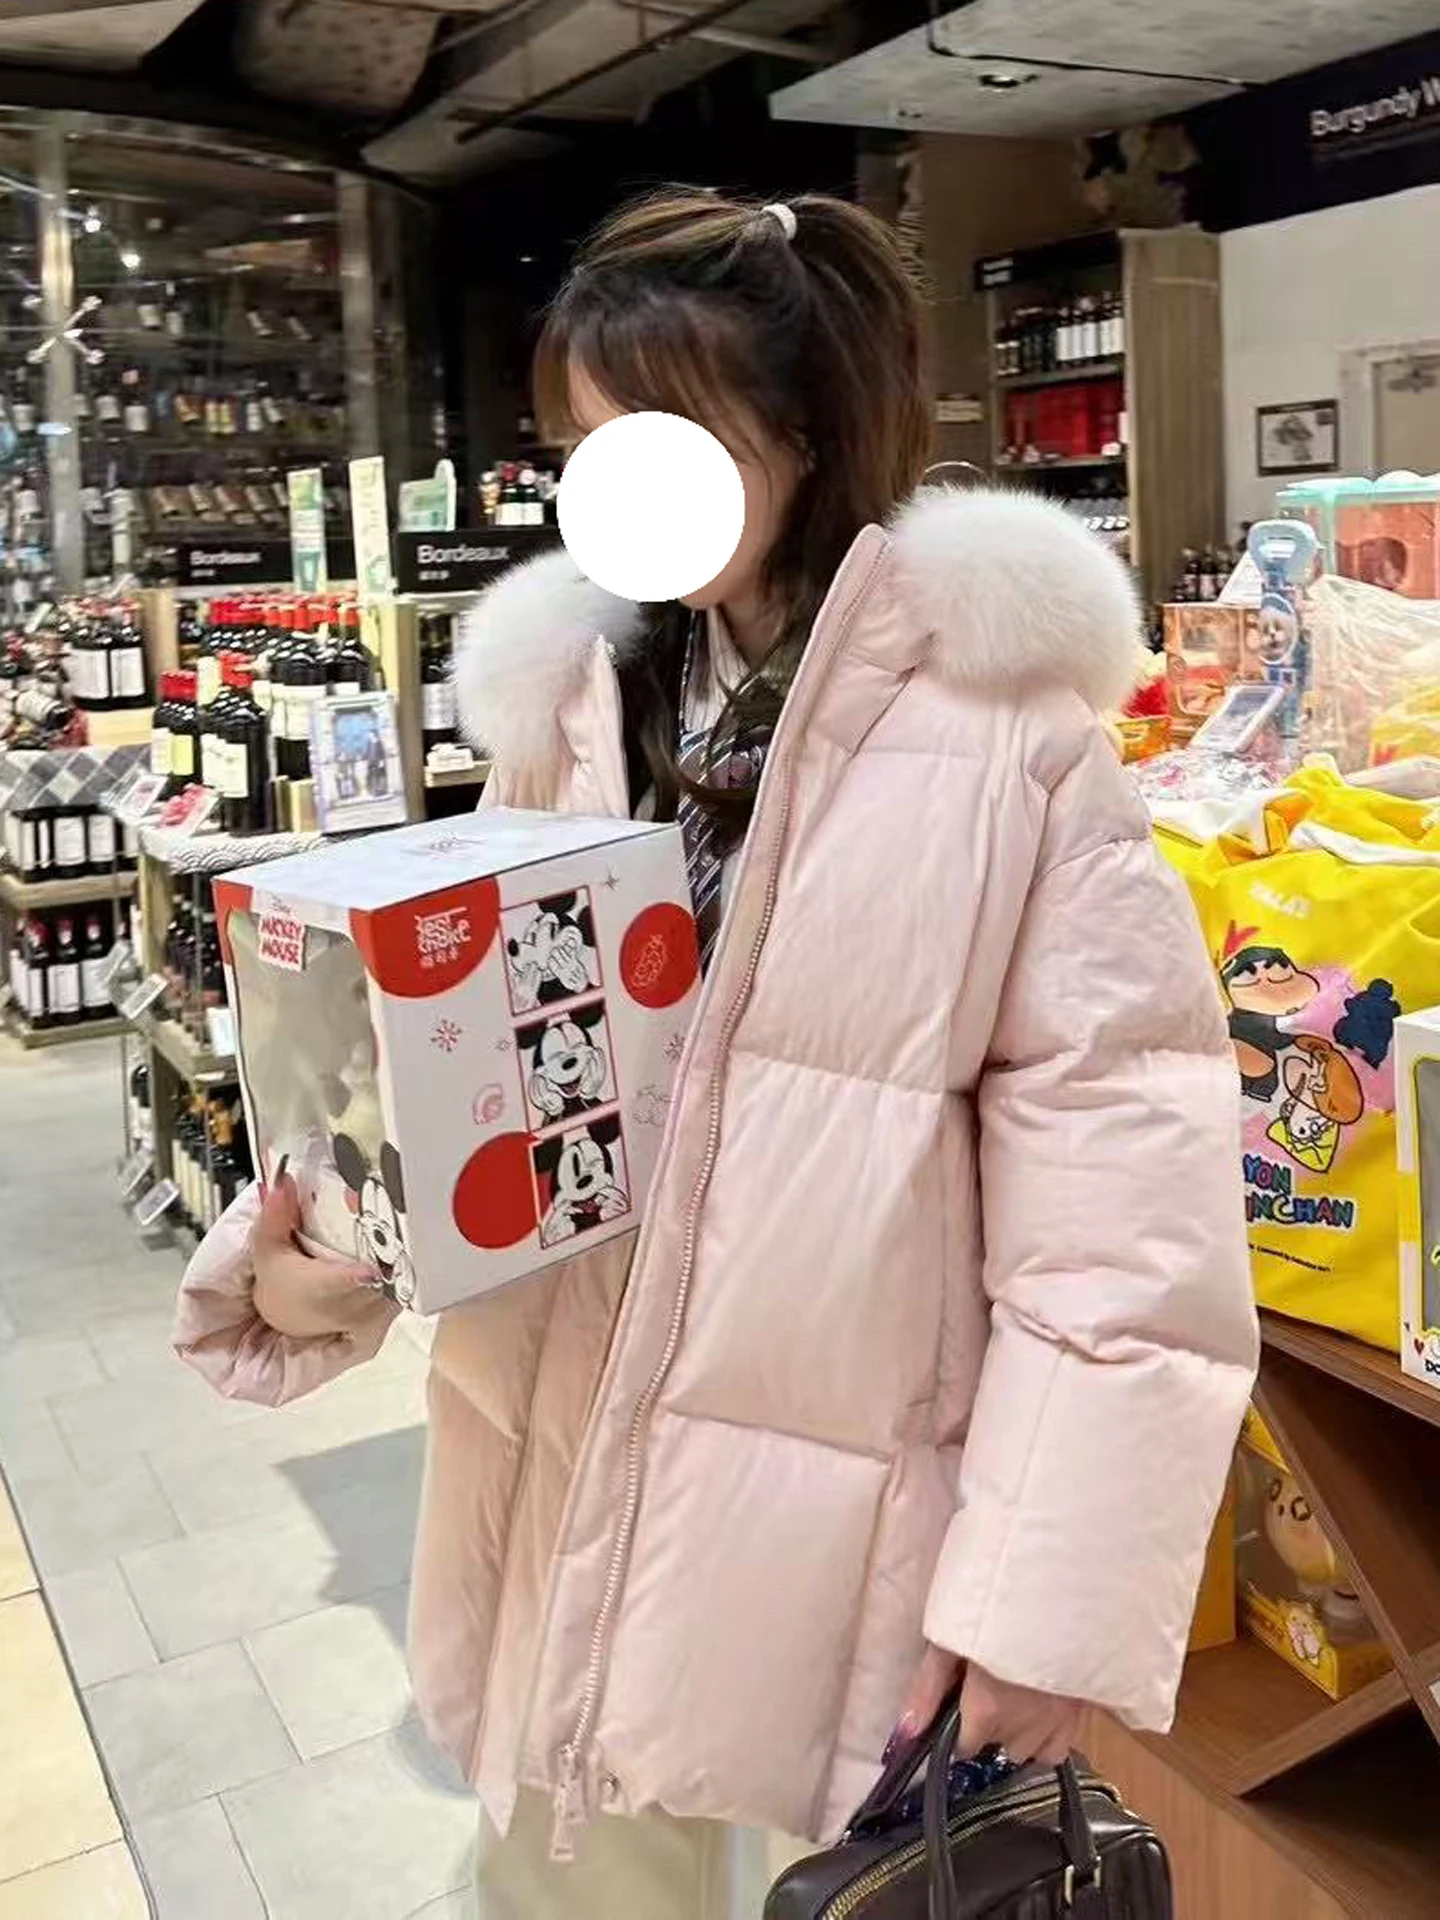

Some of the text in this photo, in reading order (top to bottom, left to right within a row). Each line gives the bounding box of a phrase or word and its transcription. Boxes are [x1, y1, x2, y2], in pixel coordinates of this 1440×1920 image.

[1309, 86, 1420, 136] Burgundy
[417, 543, 509, 564] Bordeaux
[261, 916, 301, 940] MICKEY
[262, 937, 299, 965] MOUSE
[1243, 1154, 1292, 1196] YON
[1245, 1191, 1355, 1228] INCHAN
